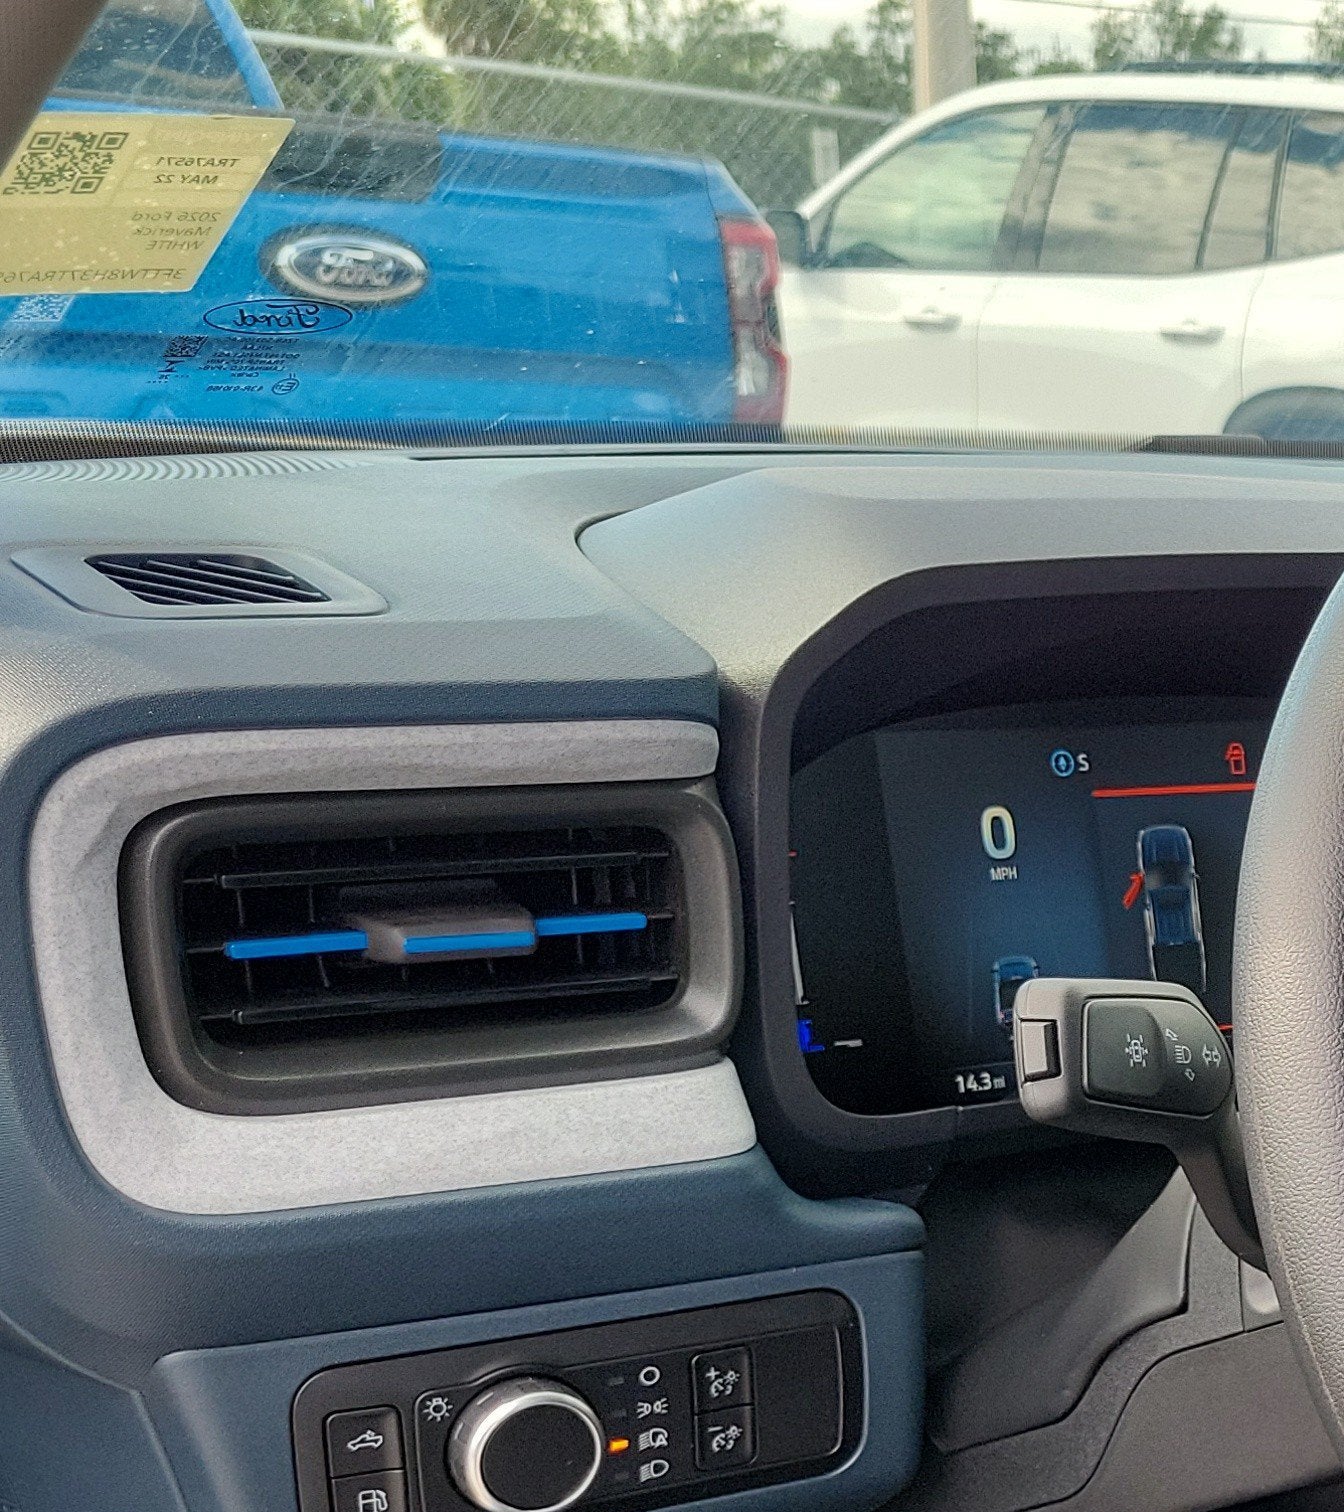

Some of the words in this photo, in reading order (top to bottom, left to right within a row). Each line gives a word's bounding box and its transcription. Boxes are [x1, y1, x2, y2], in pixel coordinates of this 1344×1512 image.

[315, 249, 394, 287] Ford
[1076, 753, 1090, 772] S
[980, 804, 1017, 860] 0
[990, 866, 1018, 881] MPH
